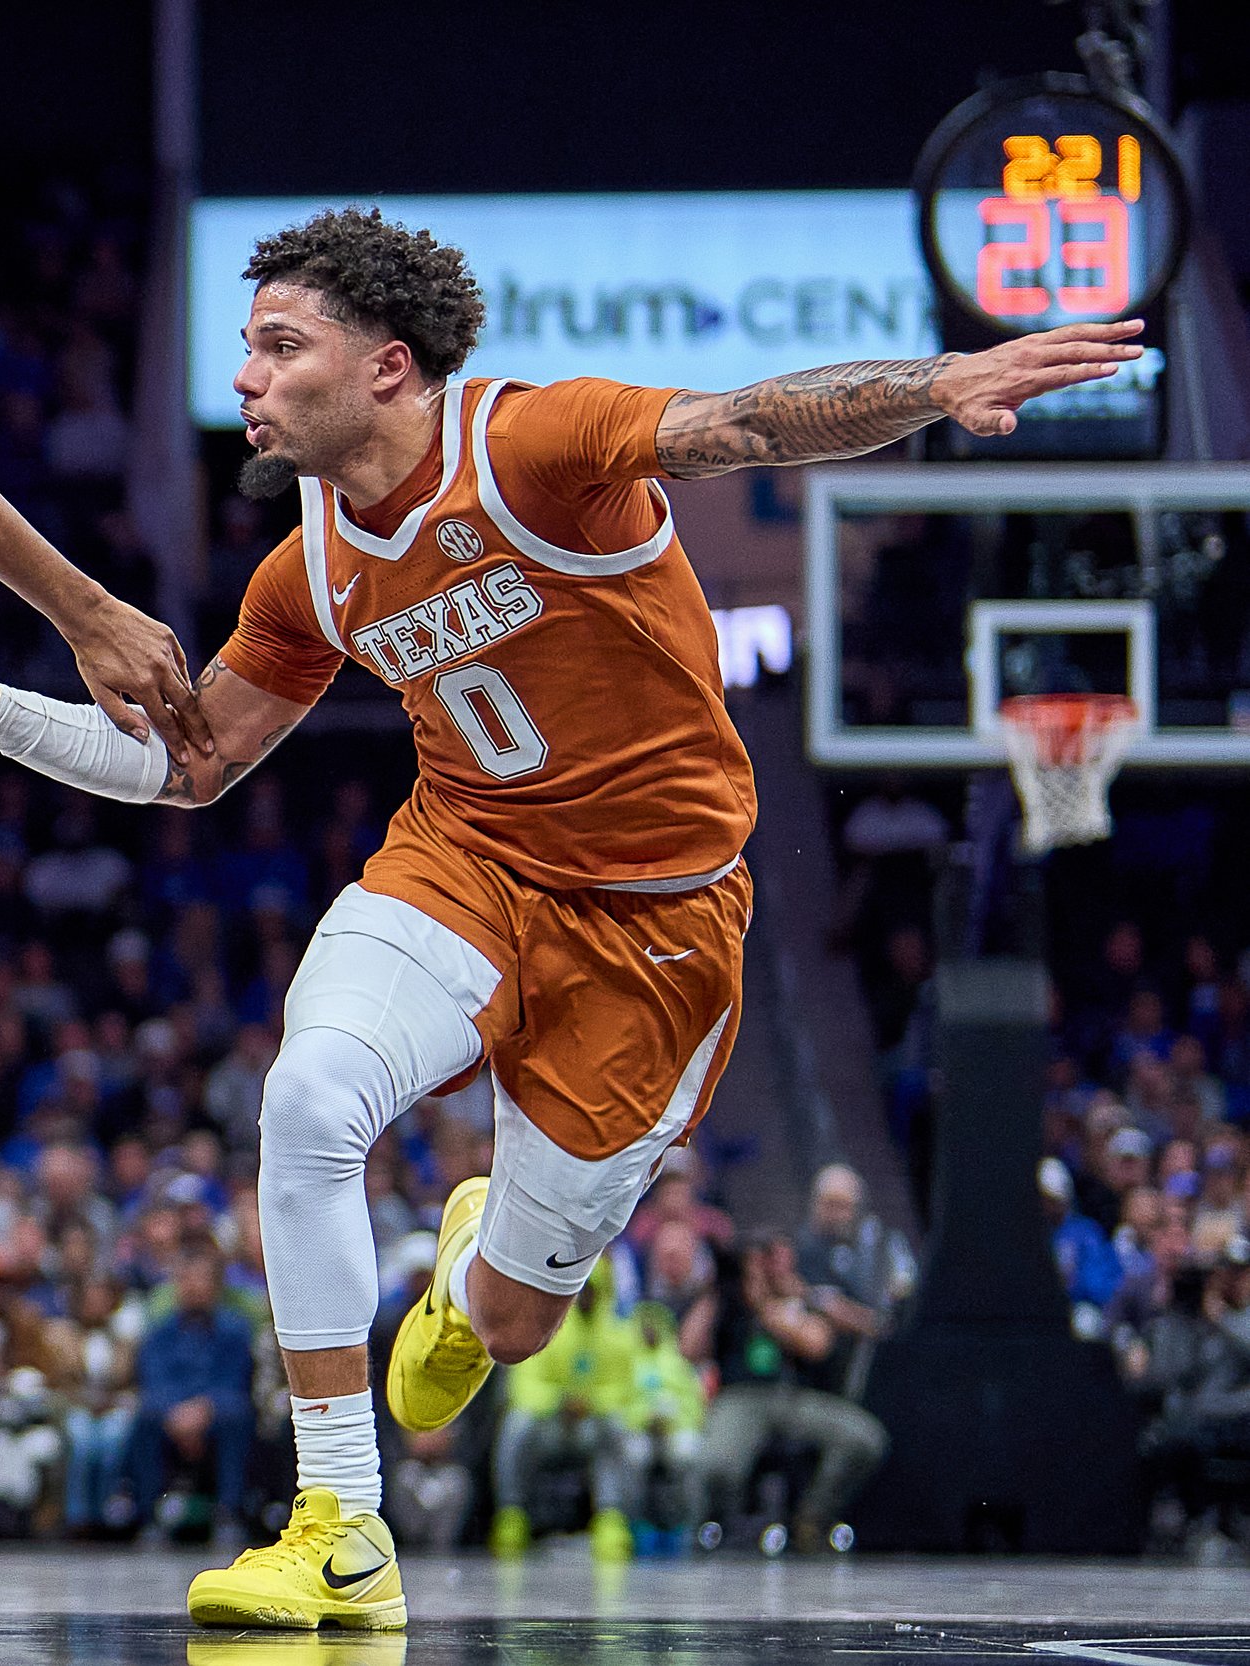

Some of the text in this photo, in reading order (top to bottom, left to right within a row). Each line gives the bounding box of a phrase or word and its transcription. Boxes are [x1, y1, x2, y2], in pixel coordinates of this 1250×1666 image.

[495, 268, 700, 348] trum
[977, 195, 1129, 316] 23
[439, 522, 480, 560] SEC
[350, 561, 544, 685] TEXAS
[433, 661, 549, 782] 0
